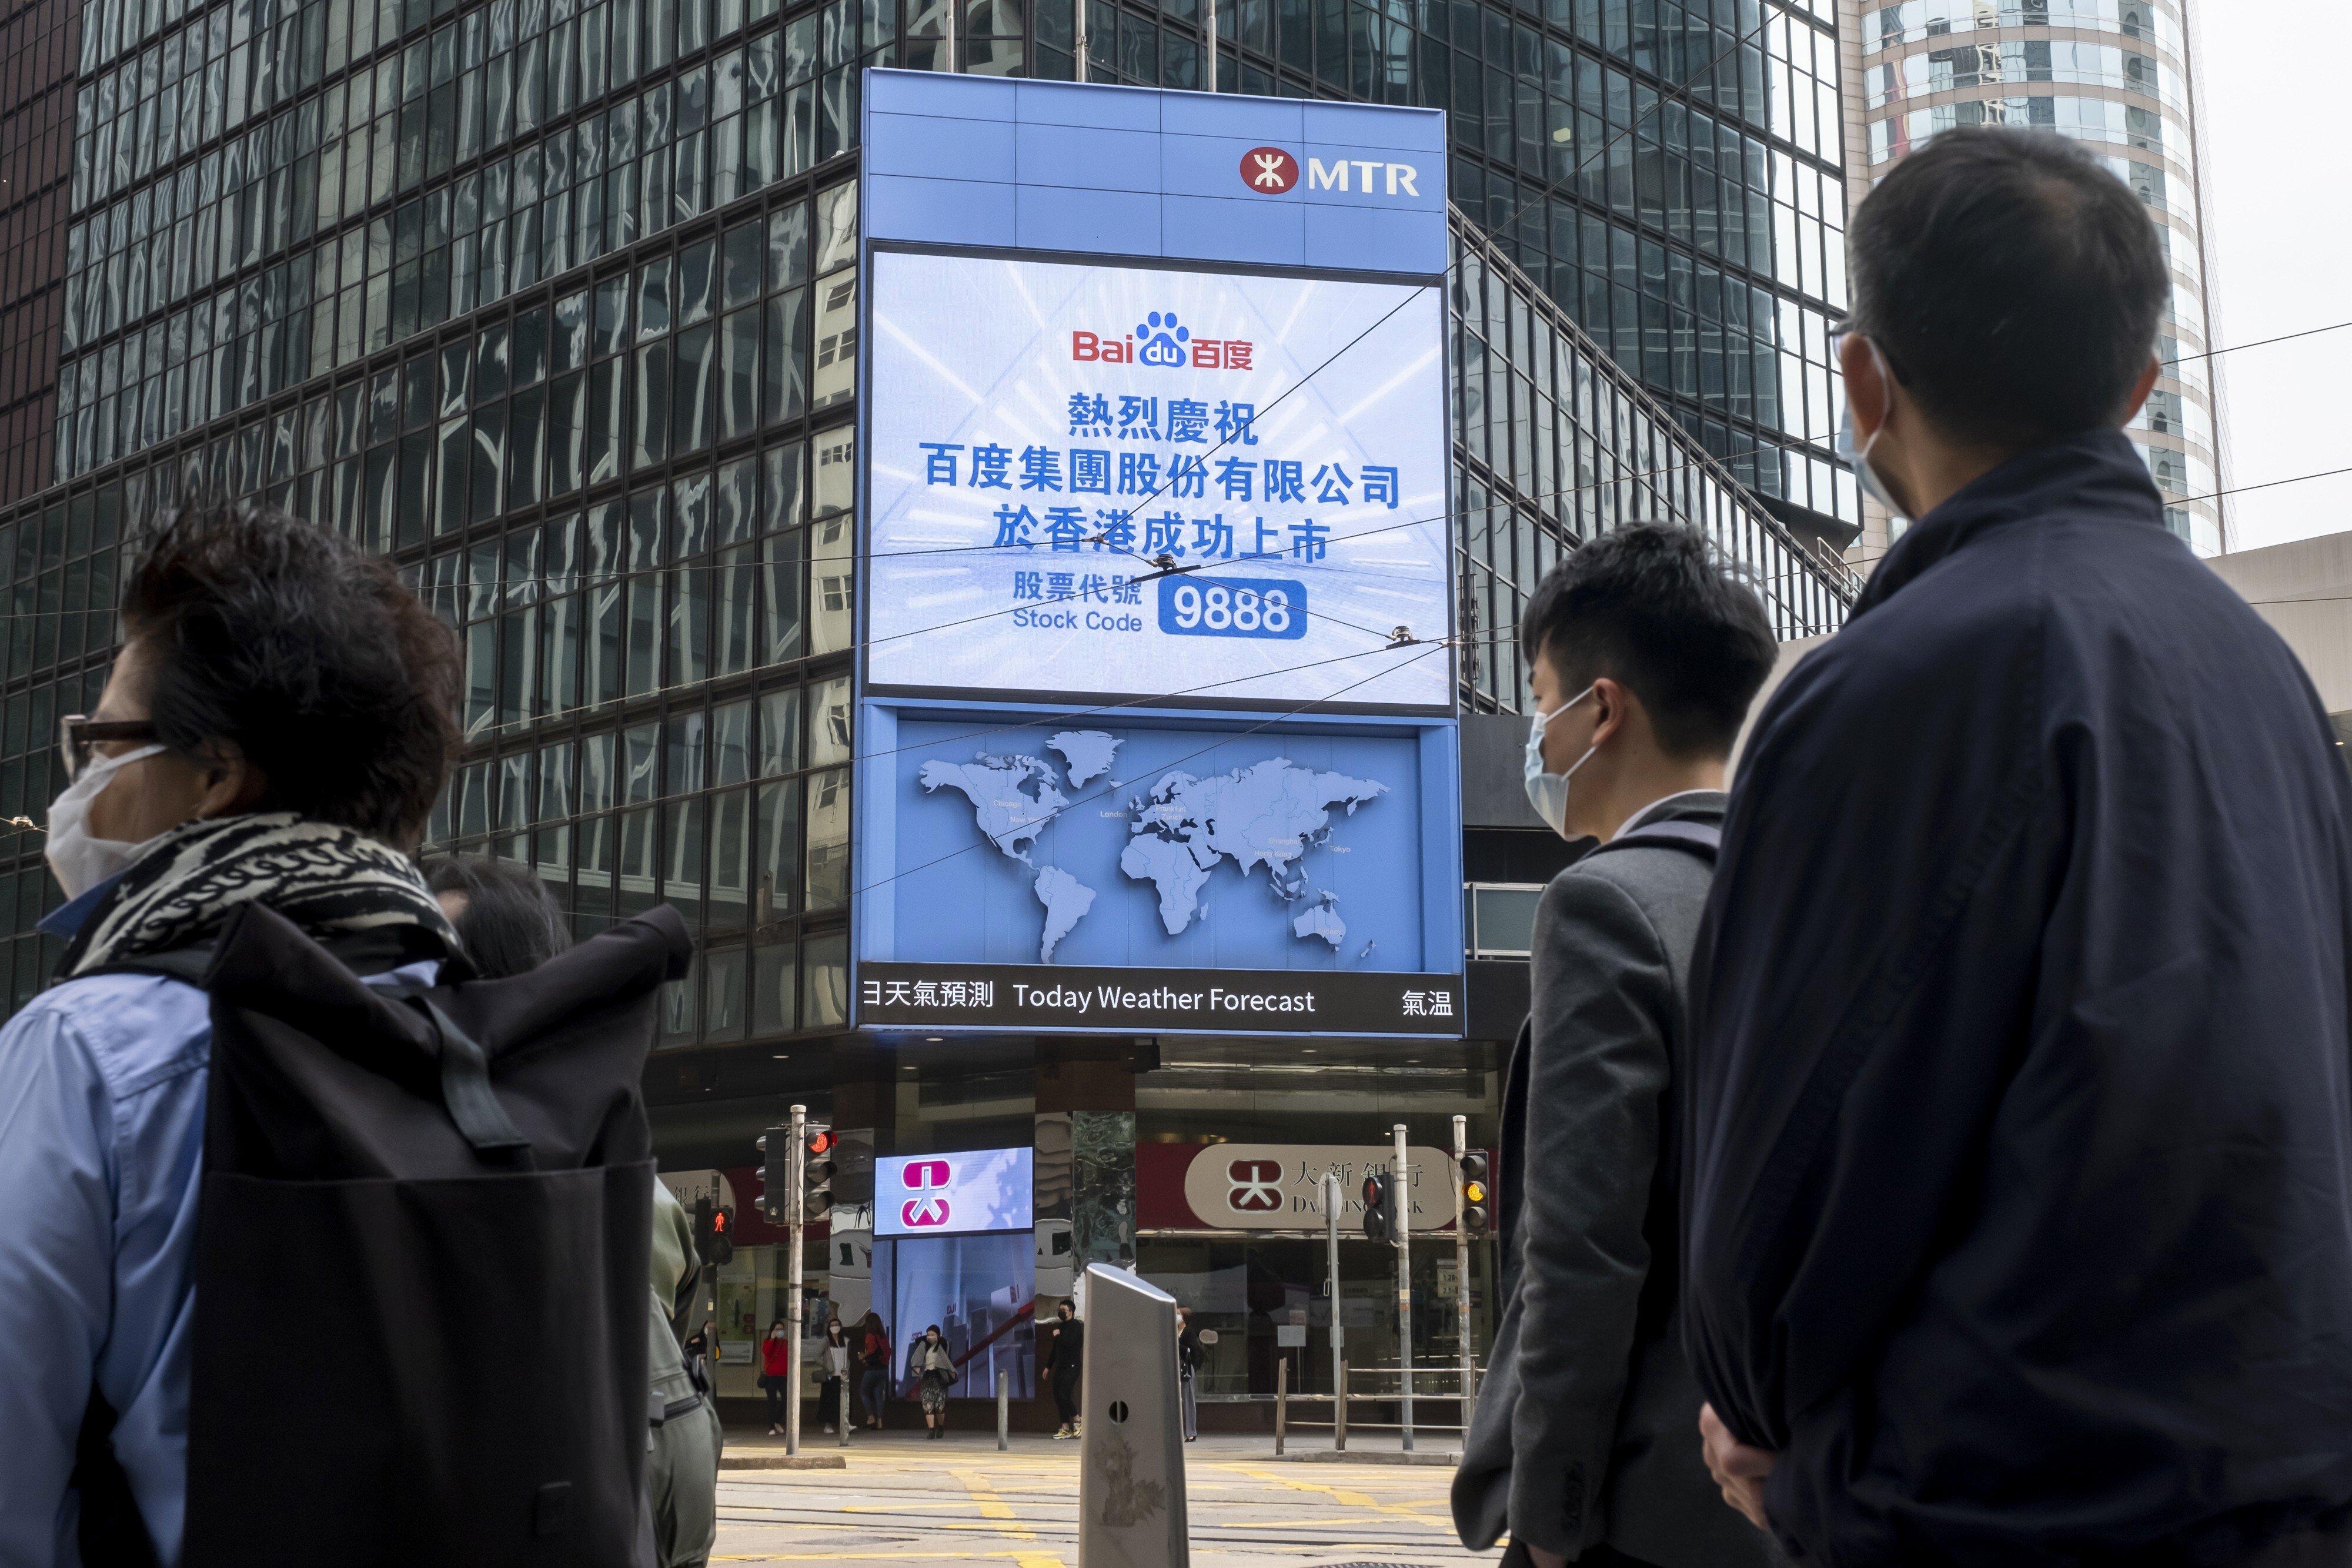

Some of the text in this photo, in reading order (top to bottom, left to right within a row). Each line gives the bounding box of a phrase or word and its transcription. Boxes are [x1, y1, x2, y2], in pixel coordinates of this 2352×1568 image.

[1308, 158, 1420, 196] MTR
[1068, 392, 1259, 446] 熱烈慶祝
[919, 442, 1399, 509] 百度集團股份有限公司
[993, 504, 1331, 564] 於香港成功上市
[1013, 571, 1142, 605] 股票代號
[1013, 609, 1142, 632] Stock Code
[1173, 586, 1290, 633] 9888
[994, 800, 1022, 808] Chicago
[1268, 837, 1300, 845] Shanghai
[1330, 845, 1351, 854] Tokyo
[1013, 984, 1315, 1014] Today Weather Forecast
